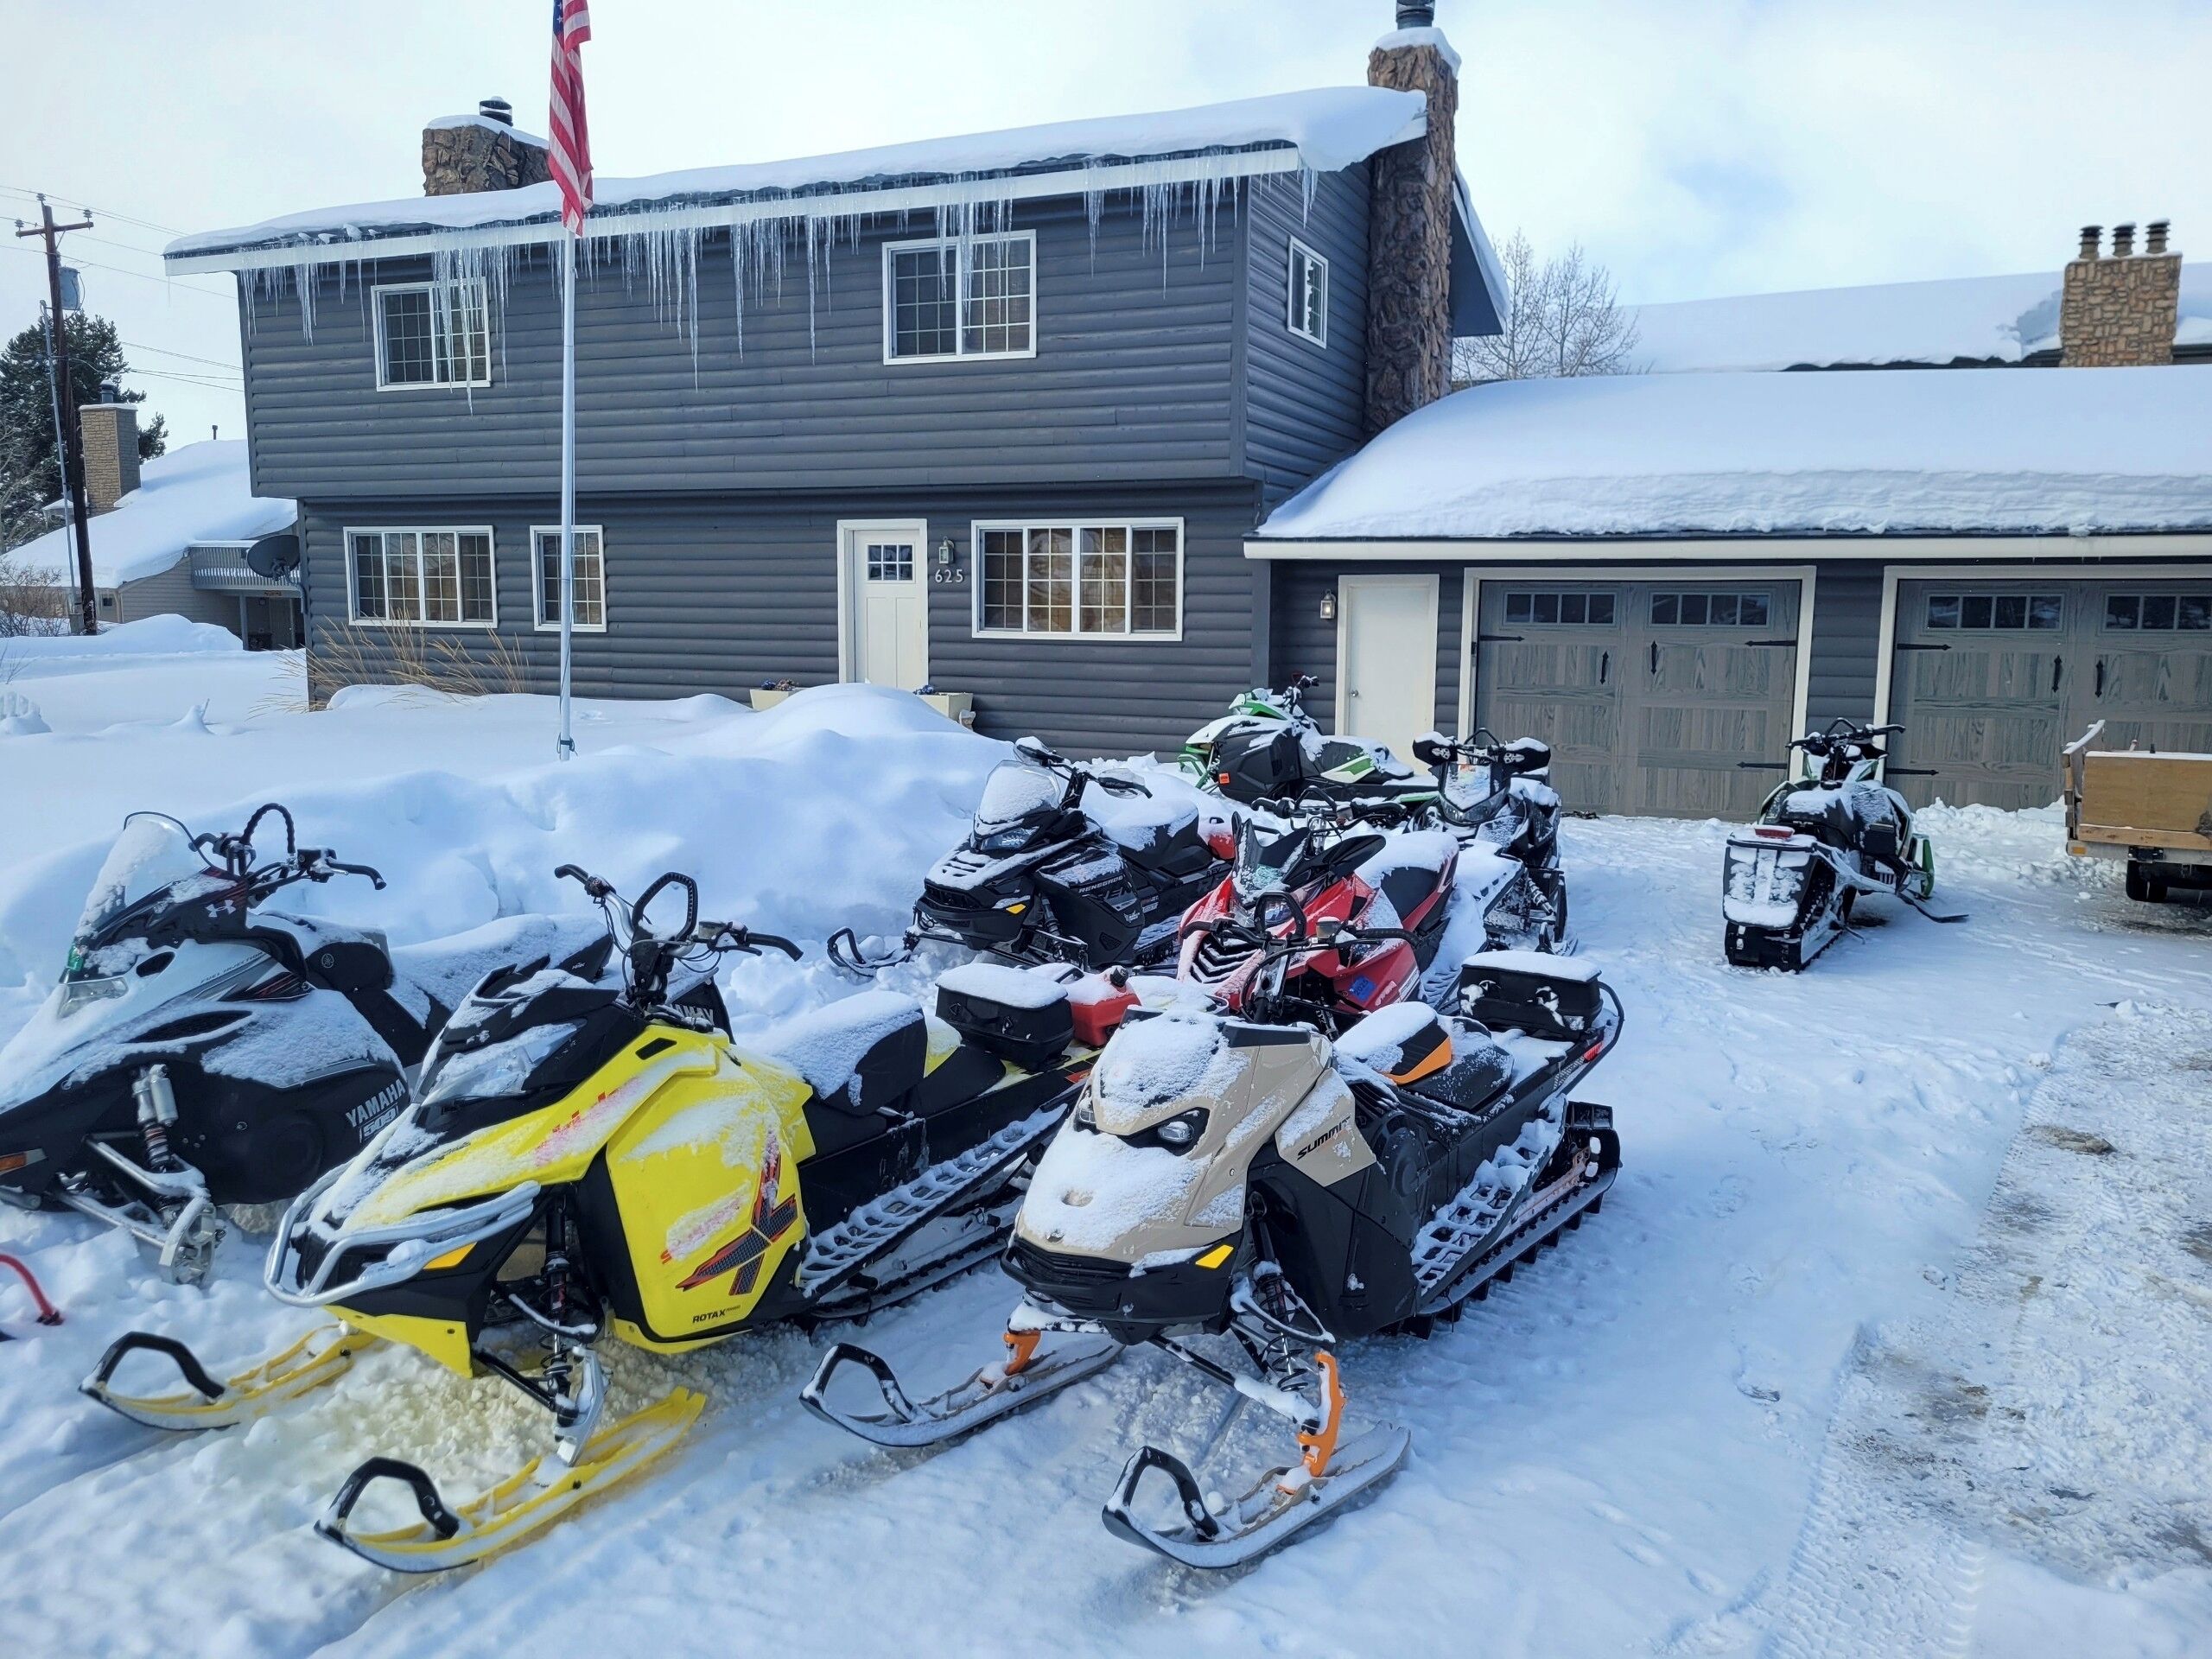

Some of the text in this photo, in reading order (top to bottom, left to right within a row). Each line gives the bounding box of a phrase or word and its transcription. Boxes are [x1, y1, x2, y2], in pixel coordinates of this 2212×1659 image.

[935, 569, 963, 583] 625
[1078, 874, 1123, 894] RENEGADE
[346, 1078, 406, 1128] YAMAHA
[363, 1108, 397, 1137] 509
[692, 1308, 727, 1324] ROTAX
